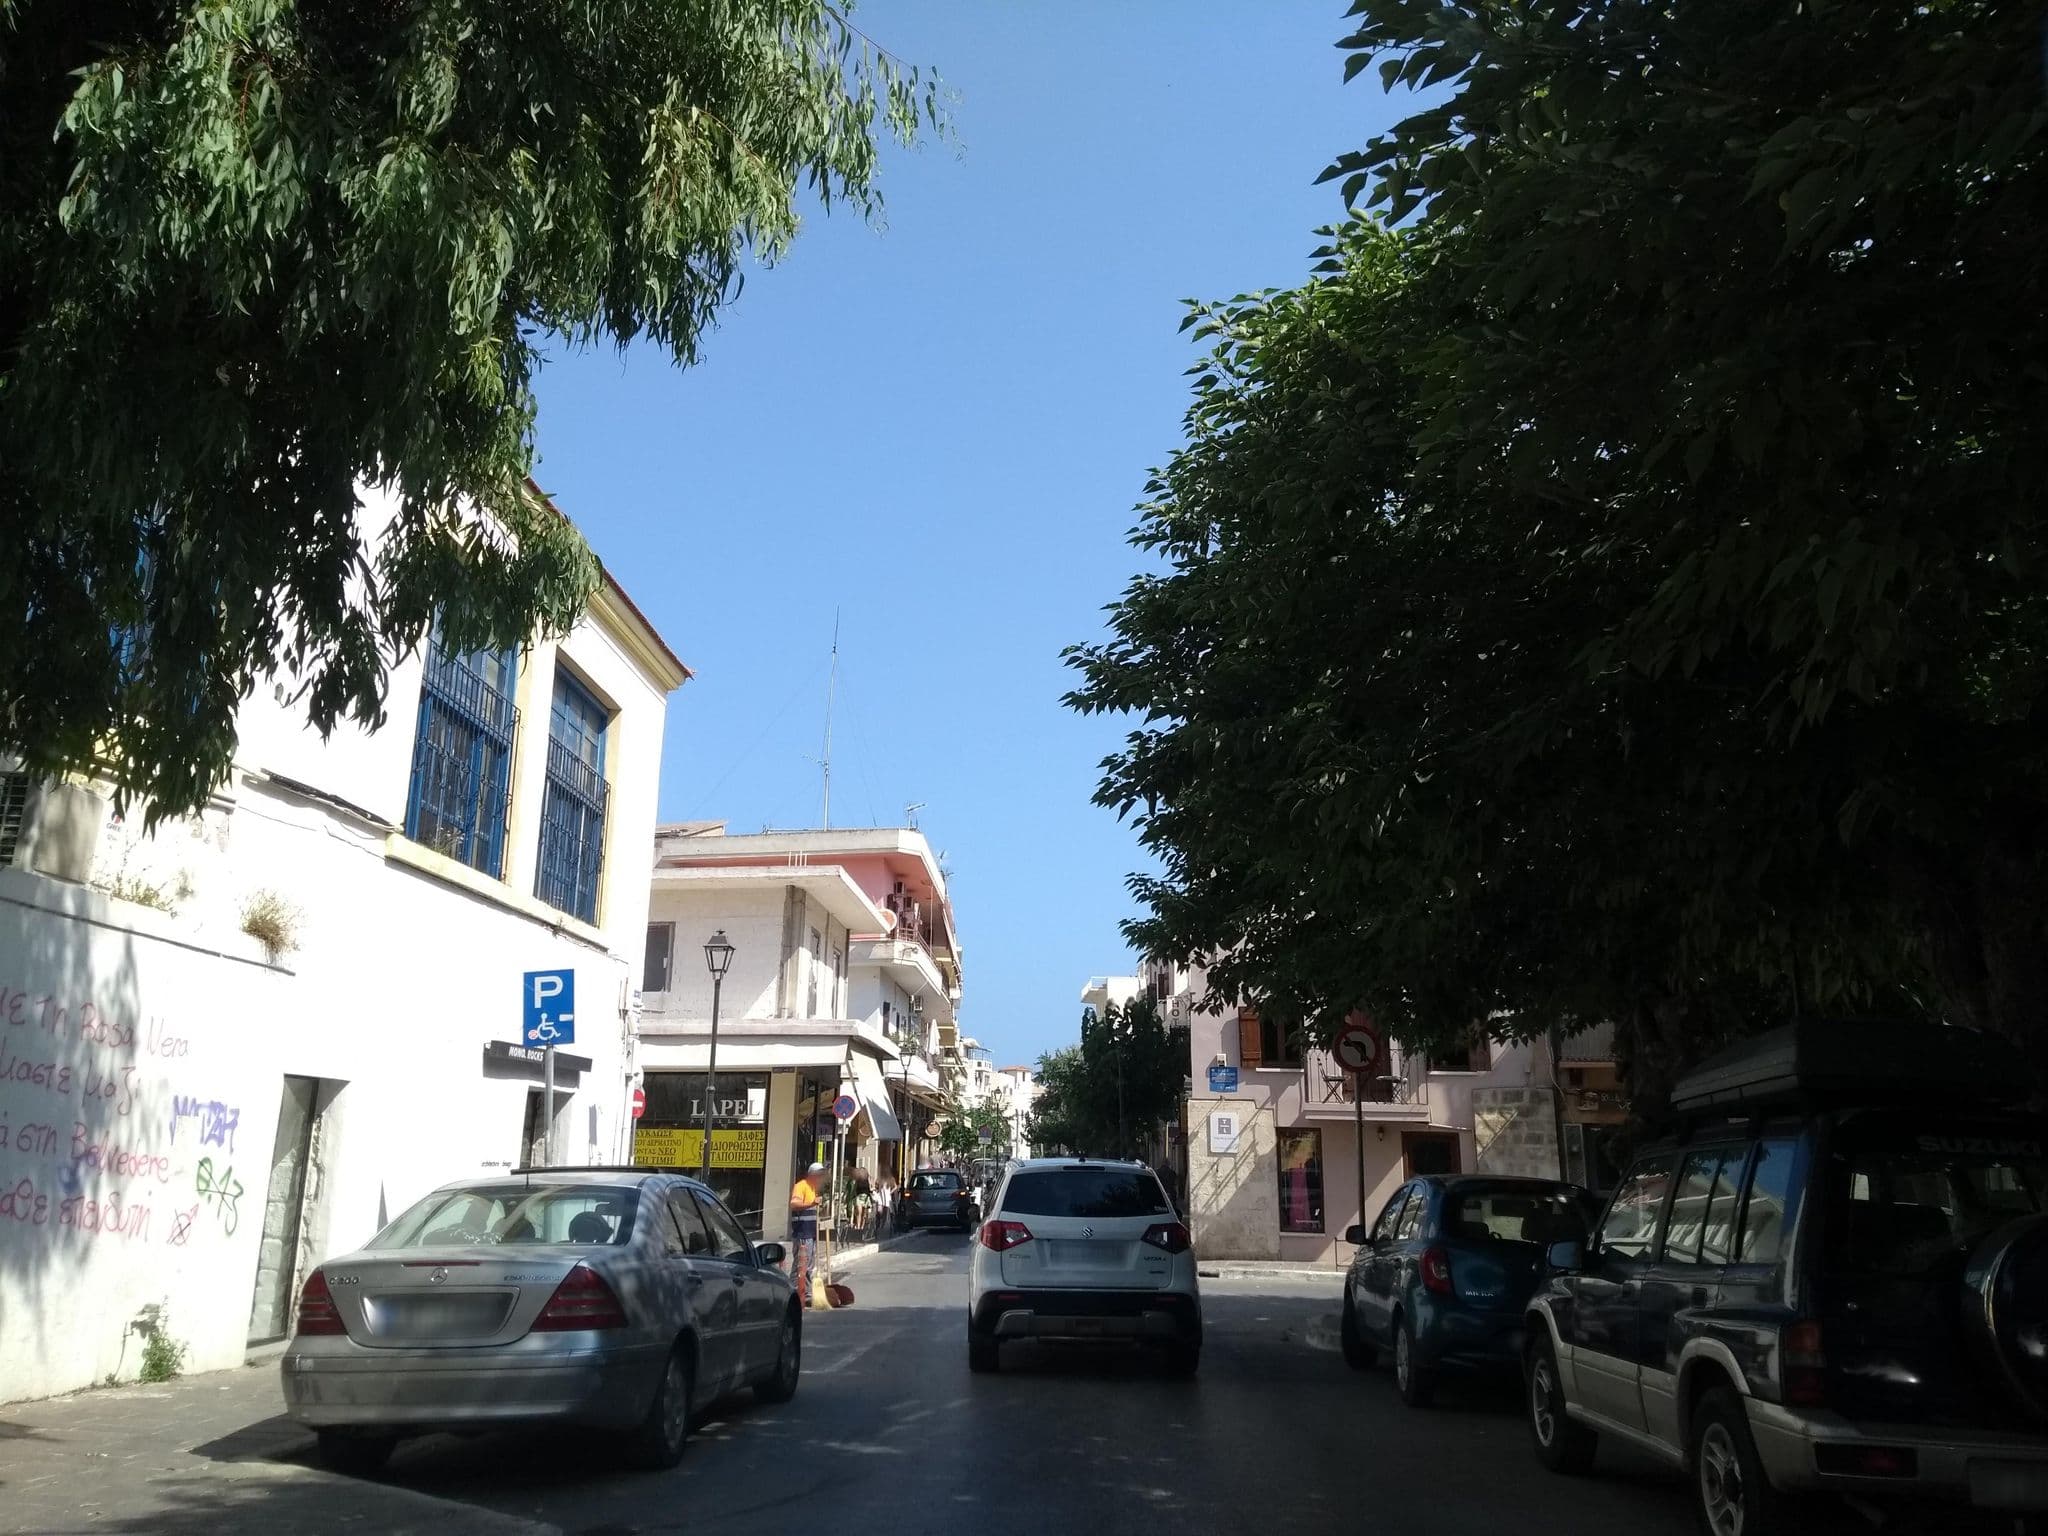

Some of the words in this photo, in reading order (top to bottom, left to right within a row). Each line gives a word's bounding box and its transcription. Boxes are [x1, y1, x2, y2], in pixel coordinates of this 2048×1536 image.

[534, 976, 563, 1009] P
[80, 1002, 134, 1048] Rosa
[690, 1099, 760, 1116] LAPEL
